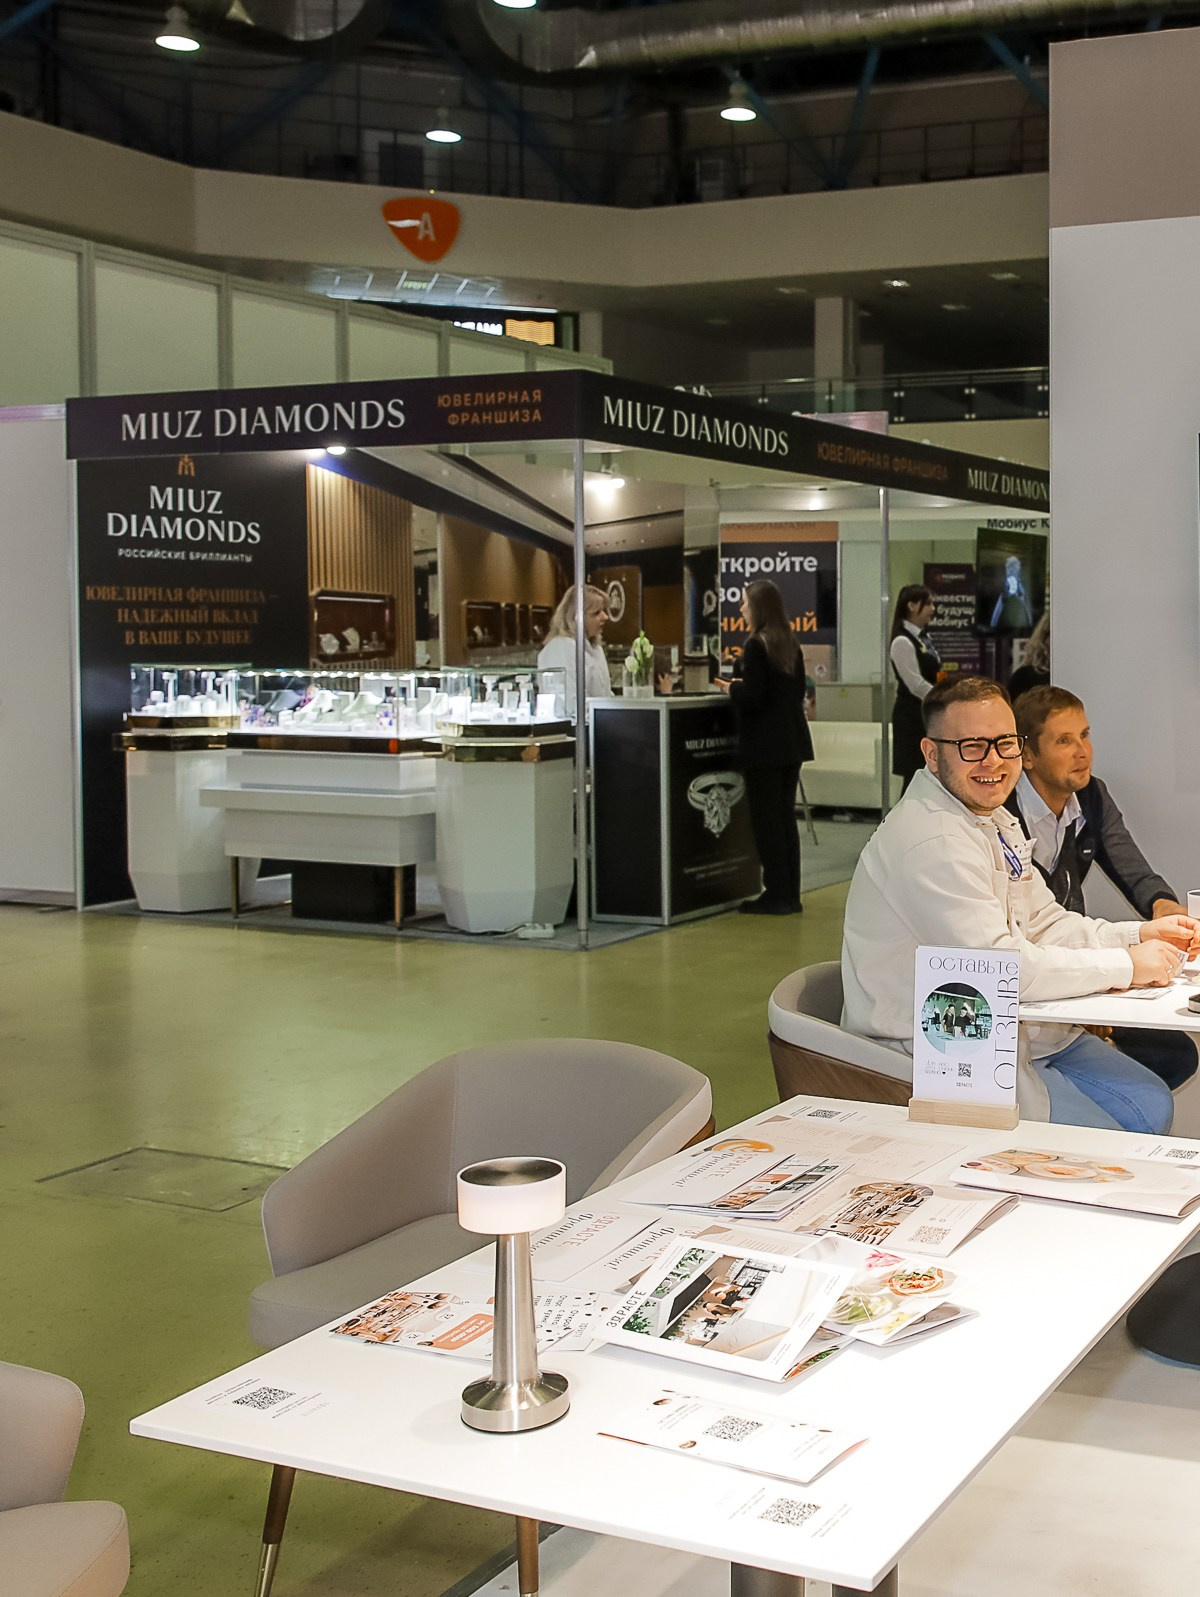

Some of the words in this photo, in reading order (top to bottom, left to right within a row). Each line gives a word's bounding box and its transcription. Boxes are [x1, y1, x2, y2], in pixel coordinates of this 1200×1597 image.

[437, 389, 543, 408] ЮВЕЛИРНАЯ
[121, 409, 203, 441] MIUZ
[213, 399, 406, 437] DIAMONDS
[447, 410, 543, 426] ФРАНШИЗА
[603, 396, 666, 435] MIUZ
[673, 410, 789, 456] DIAMONDS
[817, 442, 891, 470] ЮВЕЛИРНАЯ
[892, 458, 948, 480] ФРАНШИЗА
[967, 467, 999, 491] MIUZ
[150, 485, 223, 514] MIUZ
[106, 512, 262, 544] DIAMONDS
[117, 548, 186, 560] РОССИЙСКИЕ
[189, 552, 252, 563] БРИЛЛИАНТЫ
[86, 585, 183, 601] ЮВЕЛИРНАЯ
[719, 582, 749, 602] во
[125, 630, 135, 645] В
[139, 630, 181, 645] ВАШЕ
